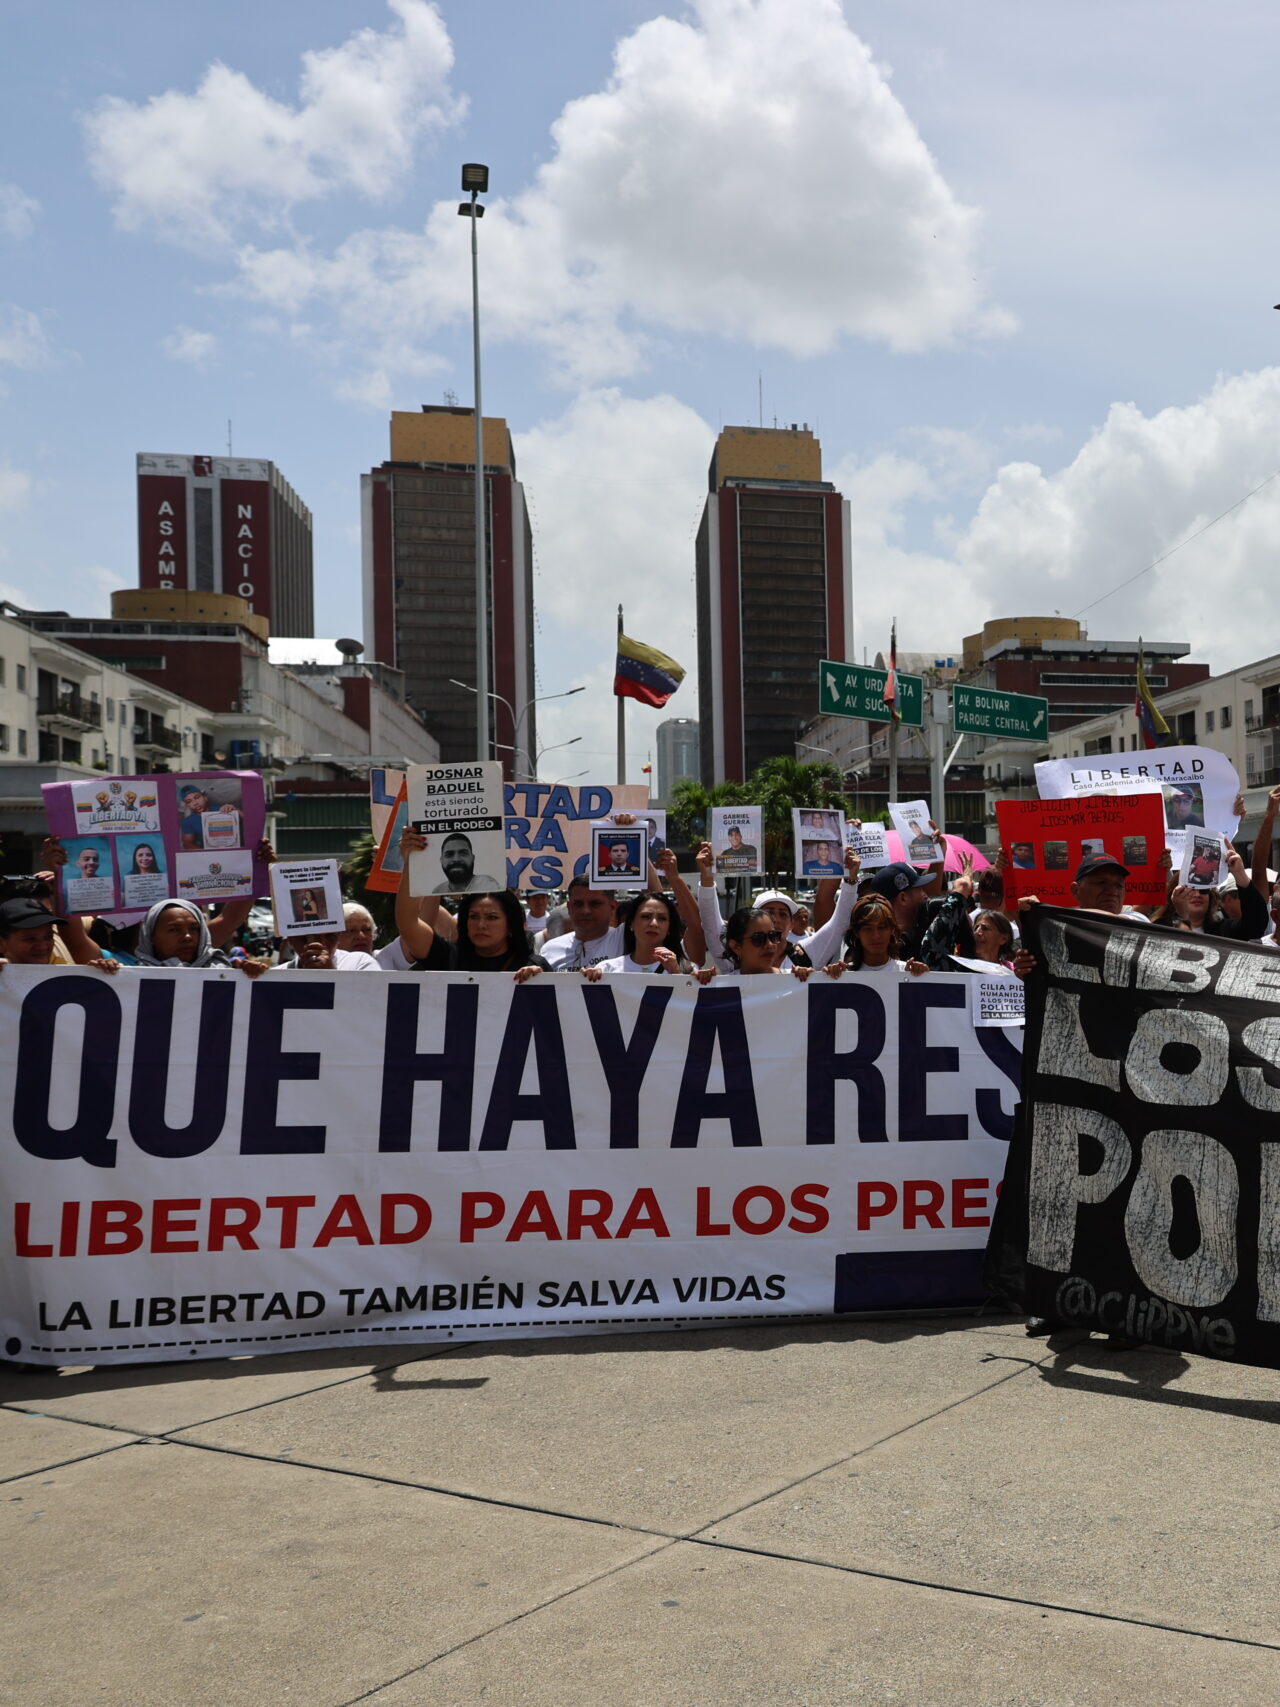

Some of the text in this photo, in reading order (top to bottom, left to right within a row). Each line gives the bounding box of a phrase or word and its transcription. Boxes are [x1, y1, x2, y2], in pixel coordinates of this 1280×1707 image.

[845, 674, 914, 697] AV. URDETA
[845, 694, 889, 712] AV. SUCR
[975, 696, 1010, 712] BOLIVAR
[958, 712, 1030, 732] PARQUE CENTRAL
[426, 767, 483, 780] JOSNAR
[1071, 759, 1204, 784] LIBERTAD
[427, 782, 484, 795] BADUEL
[1073, 783, 1093, 791] Caso
[1094, 780, 1133, 788] Academia
[1163, 774, 1204, 782] Maracaibo
[425, 796, 484, 806] está siendo
[1085, 795, 1139, 809] LIBERTAD
[424, 805, 488, 818] torturado
[420, 820, 494, 832] EN EL RODEO
[981, 983, 1006, 991] CILIA
[13, 975, 335, 1168] QUE
[378, 983, 763, 1152] HAYA
[14, 1177, 1004, 1258] LIBERTAD PARA LOS PRE
[38, 1274, 787, 1332] LA LIBERTAD TAMBIÉN SALVA VIDAS
